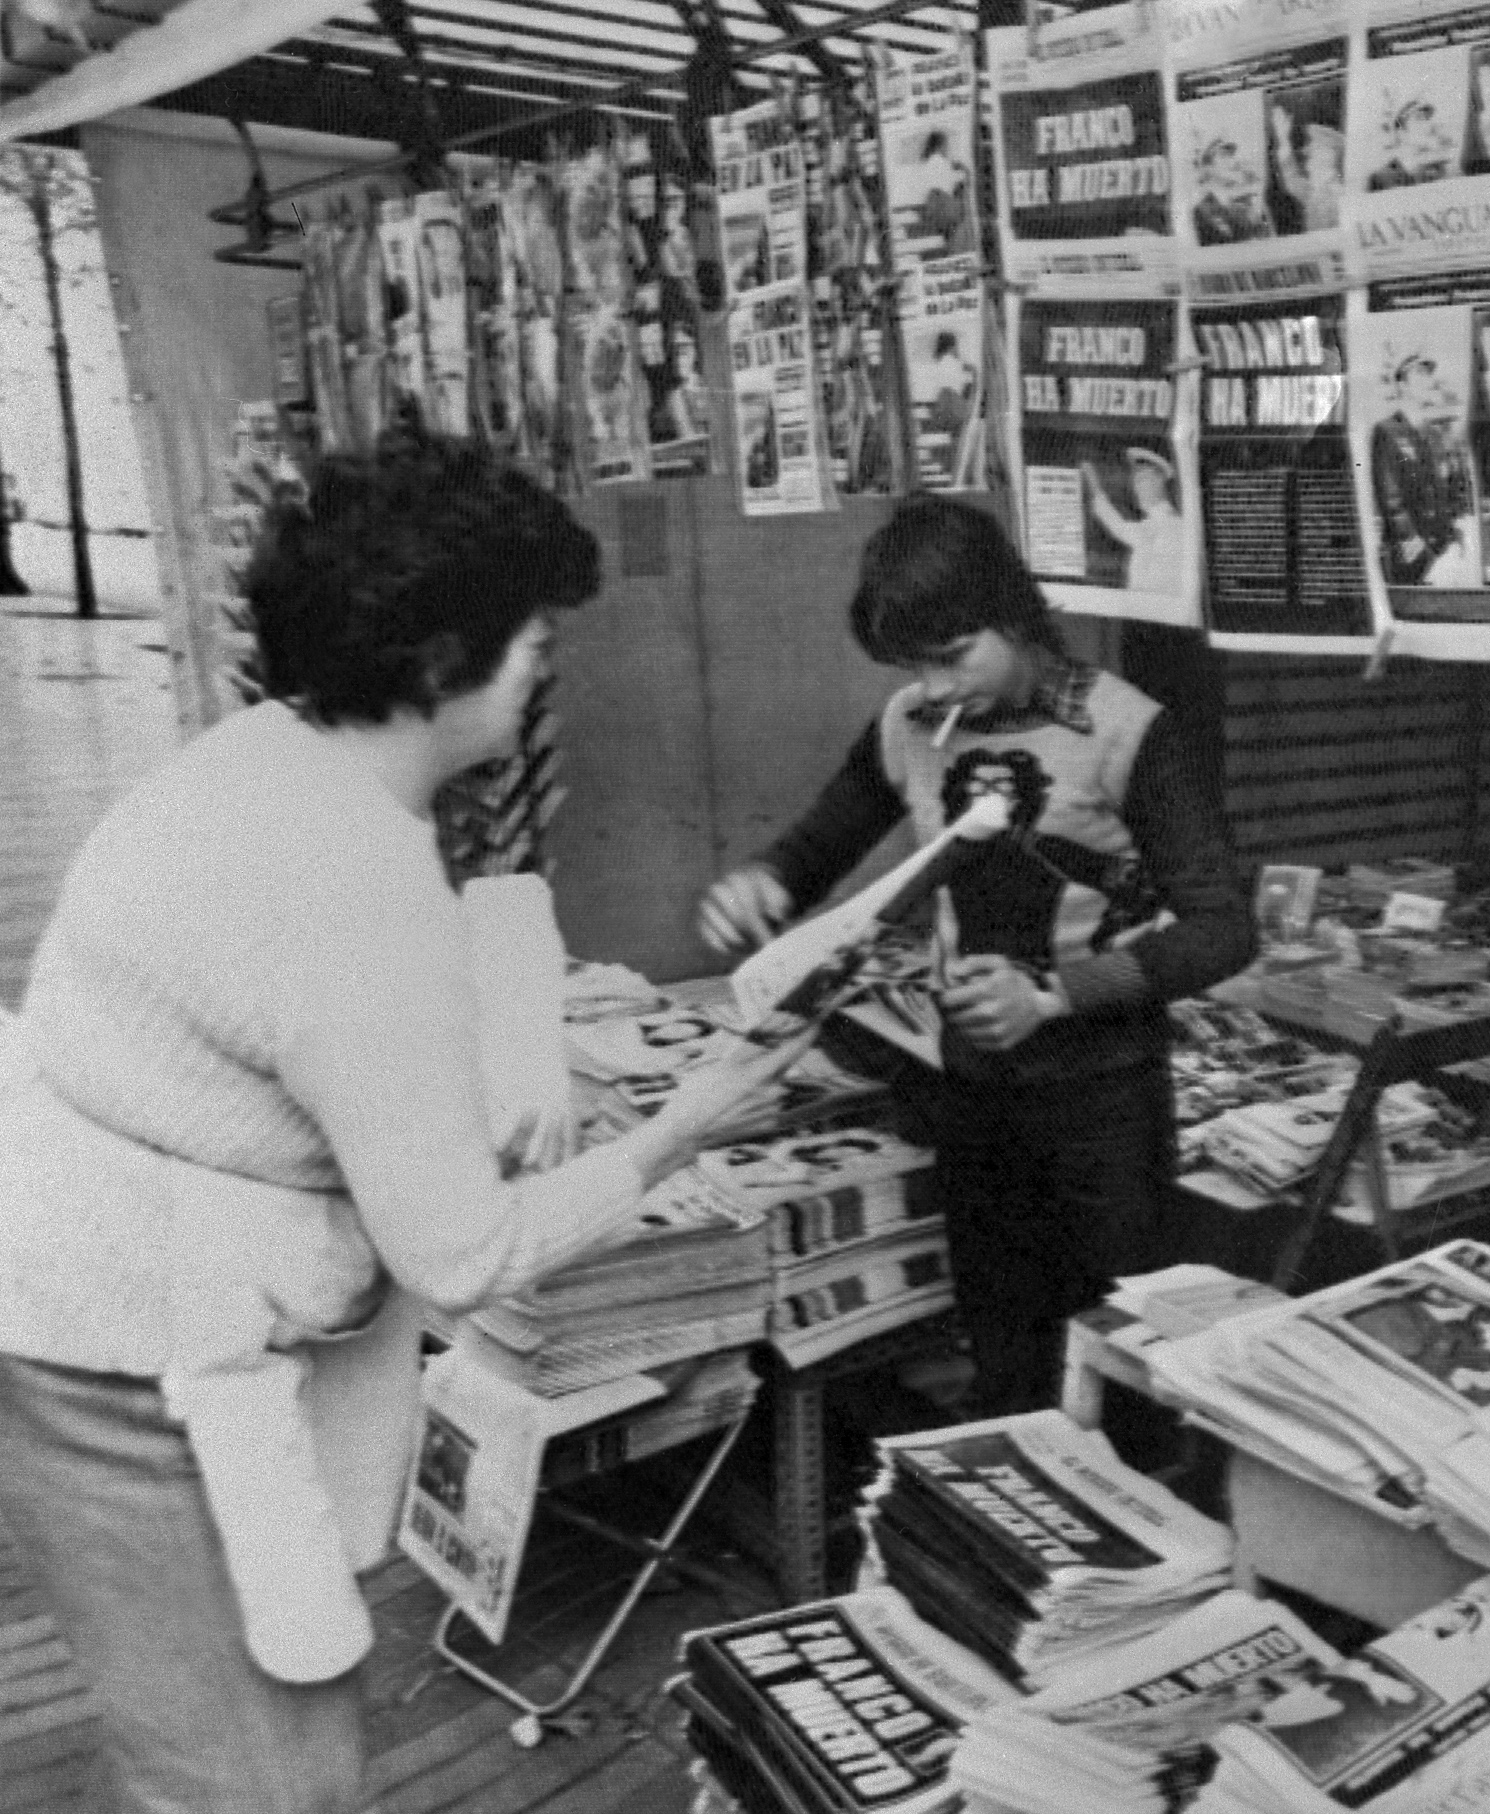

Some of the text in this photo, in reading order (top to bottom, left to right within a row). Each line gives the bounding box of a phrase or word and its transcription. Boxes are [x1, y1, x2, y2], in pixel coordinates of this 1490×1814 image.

[1024, 375, 1060, 413] HA
[1208, 377, 1246, 426] HA
[722, 1628, 917, 1799] HA MUERTO
[784, 1617, 935, 1742] FRANCO
